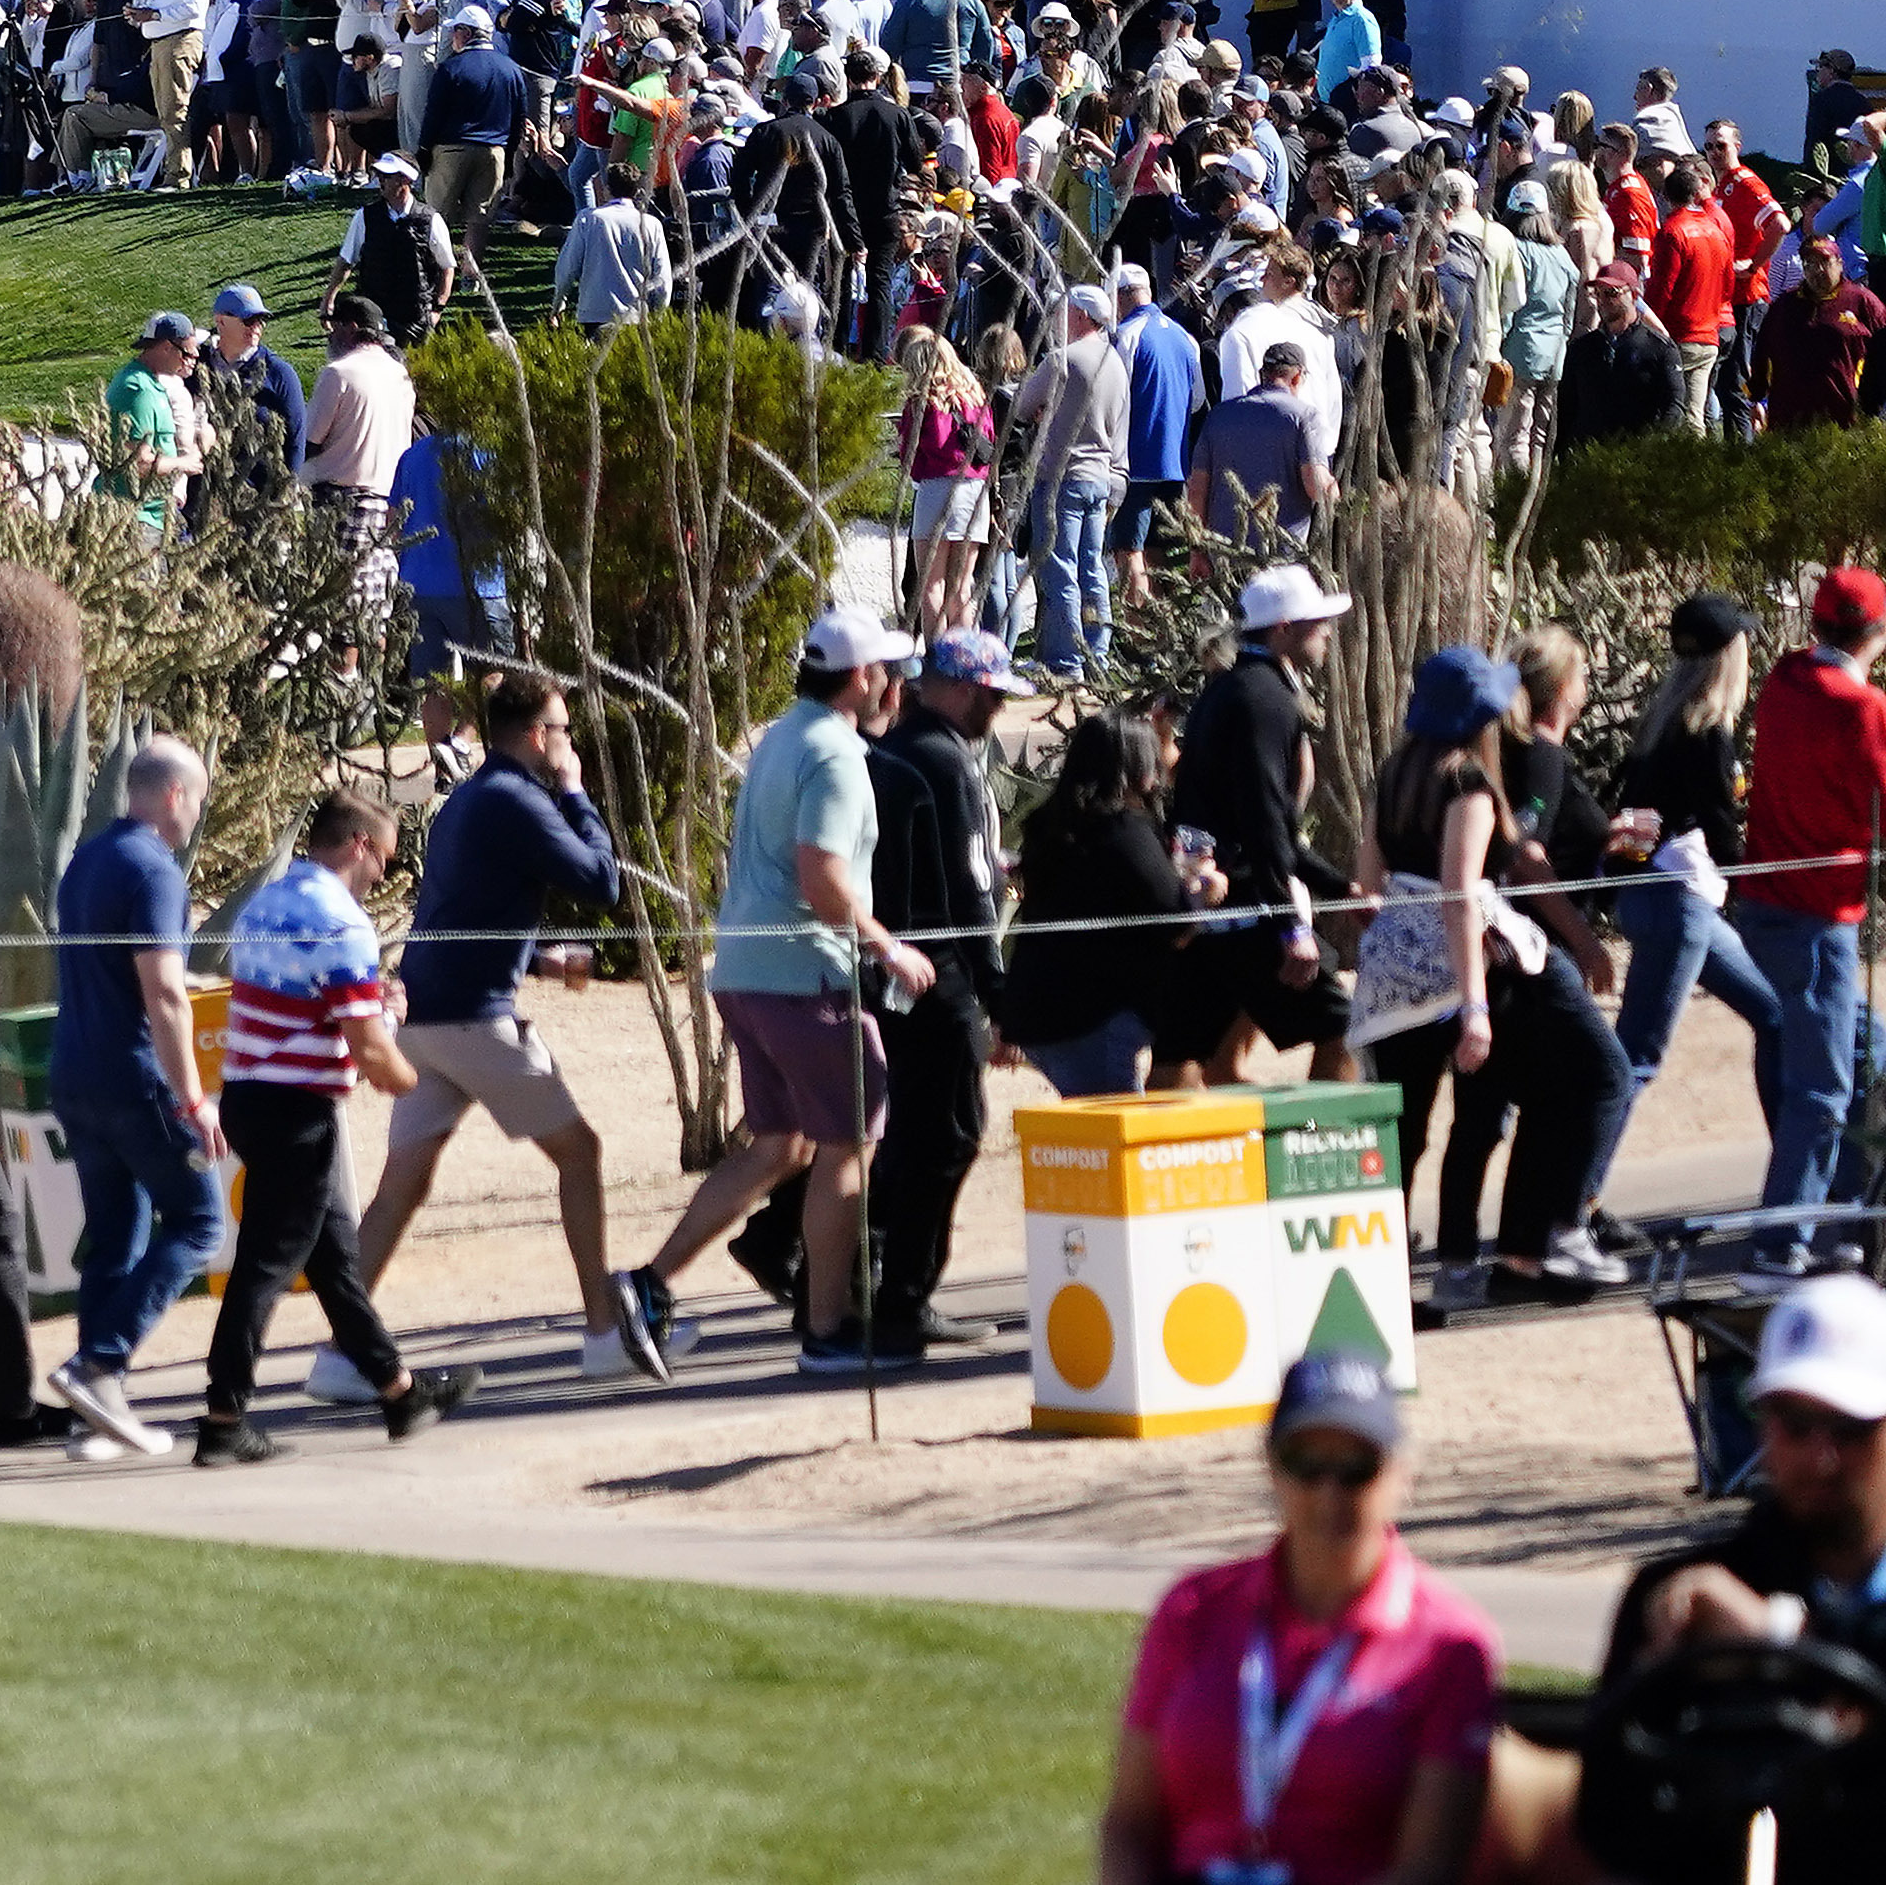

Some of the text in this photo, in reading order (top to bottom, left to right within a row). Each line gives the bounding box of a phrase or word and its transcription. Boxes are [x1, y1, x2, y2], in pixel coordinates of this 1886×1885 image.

[1030, 1145, 1110, 1170] COMPOST
[1138, 1136, 1246, 1171] COMPOST
[1282, 1210, 1392, 1254] WM
